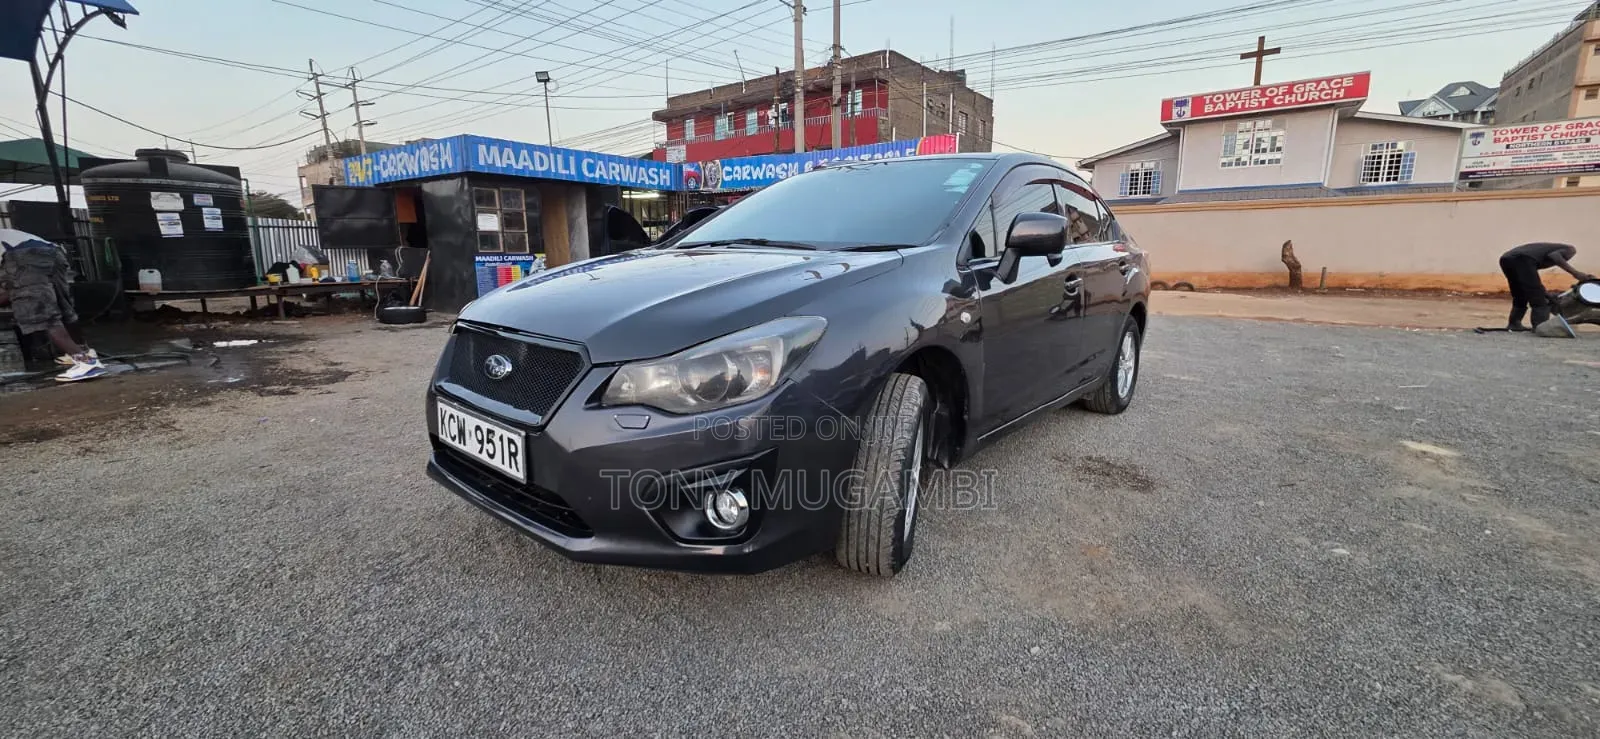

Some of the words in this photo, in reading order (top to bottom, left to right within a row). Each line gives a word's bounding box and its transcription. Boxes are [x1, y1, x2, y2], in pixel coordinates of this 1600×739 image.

[1203, 98, 1269, 113] BAPTIST
[1273, 88, 1345, 105] CHURCH
[1204, 89, 1261, 104] TOWER
[1265, 86, 1289, 97] OF
[1293, 76, 1354, 93] GRACE
[1492, 126, 1540, 137] TOWER
[1543, 124, 1562, 132] OF
[1565, 120, 1600, 130] GRAC
[1493, 133, 1547, 144] BAPTIST
[1550, 128, 1600, 139] CHURC
[478, 144, 576, 175] MAADILI
[581, 158, 671, 186] CARWASH
[722, 160, 799, 182] CARWASH
[440, 407, 467, 447] KCW
[474, 424, 520, 473] 951R
